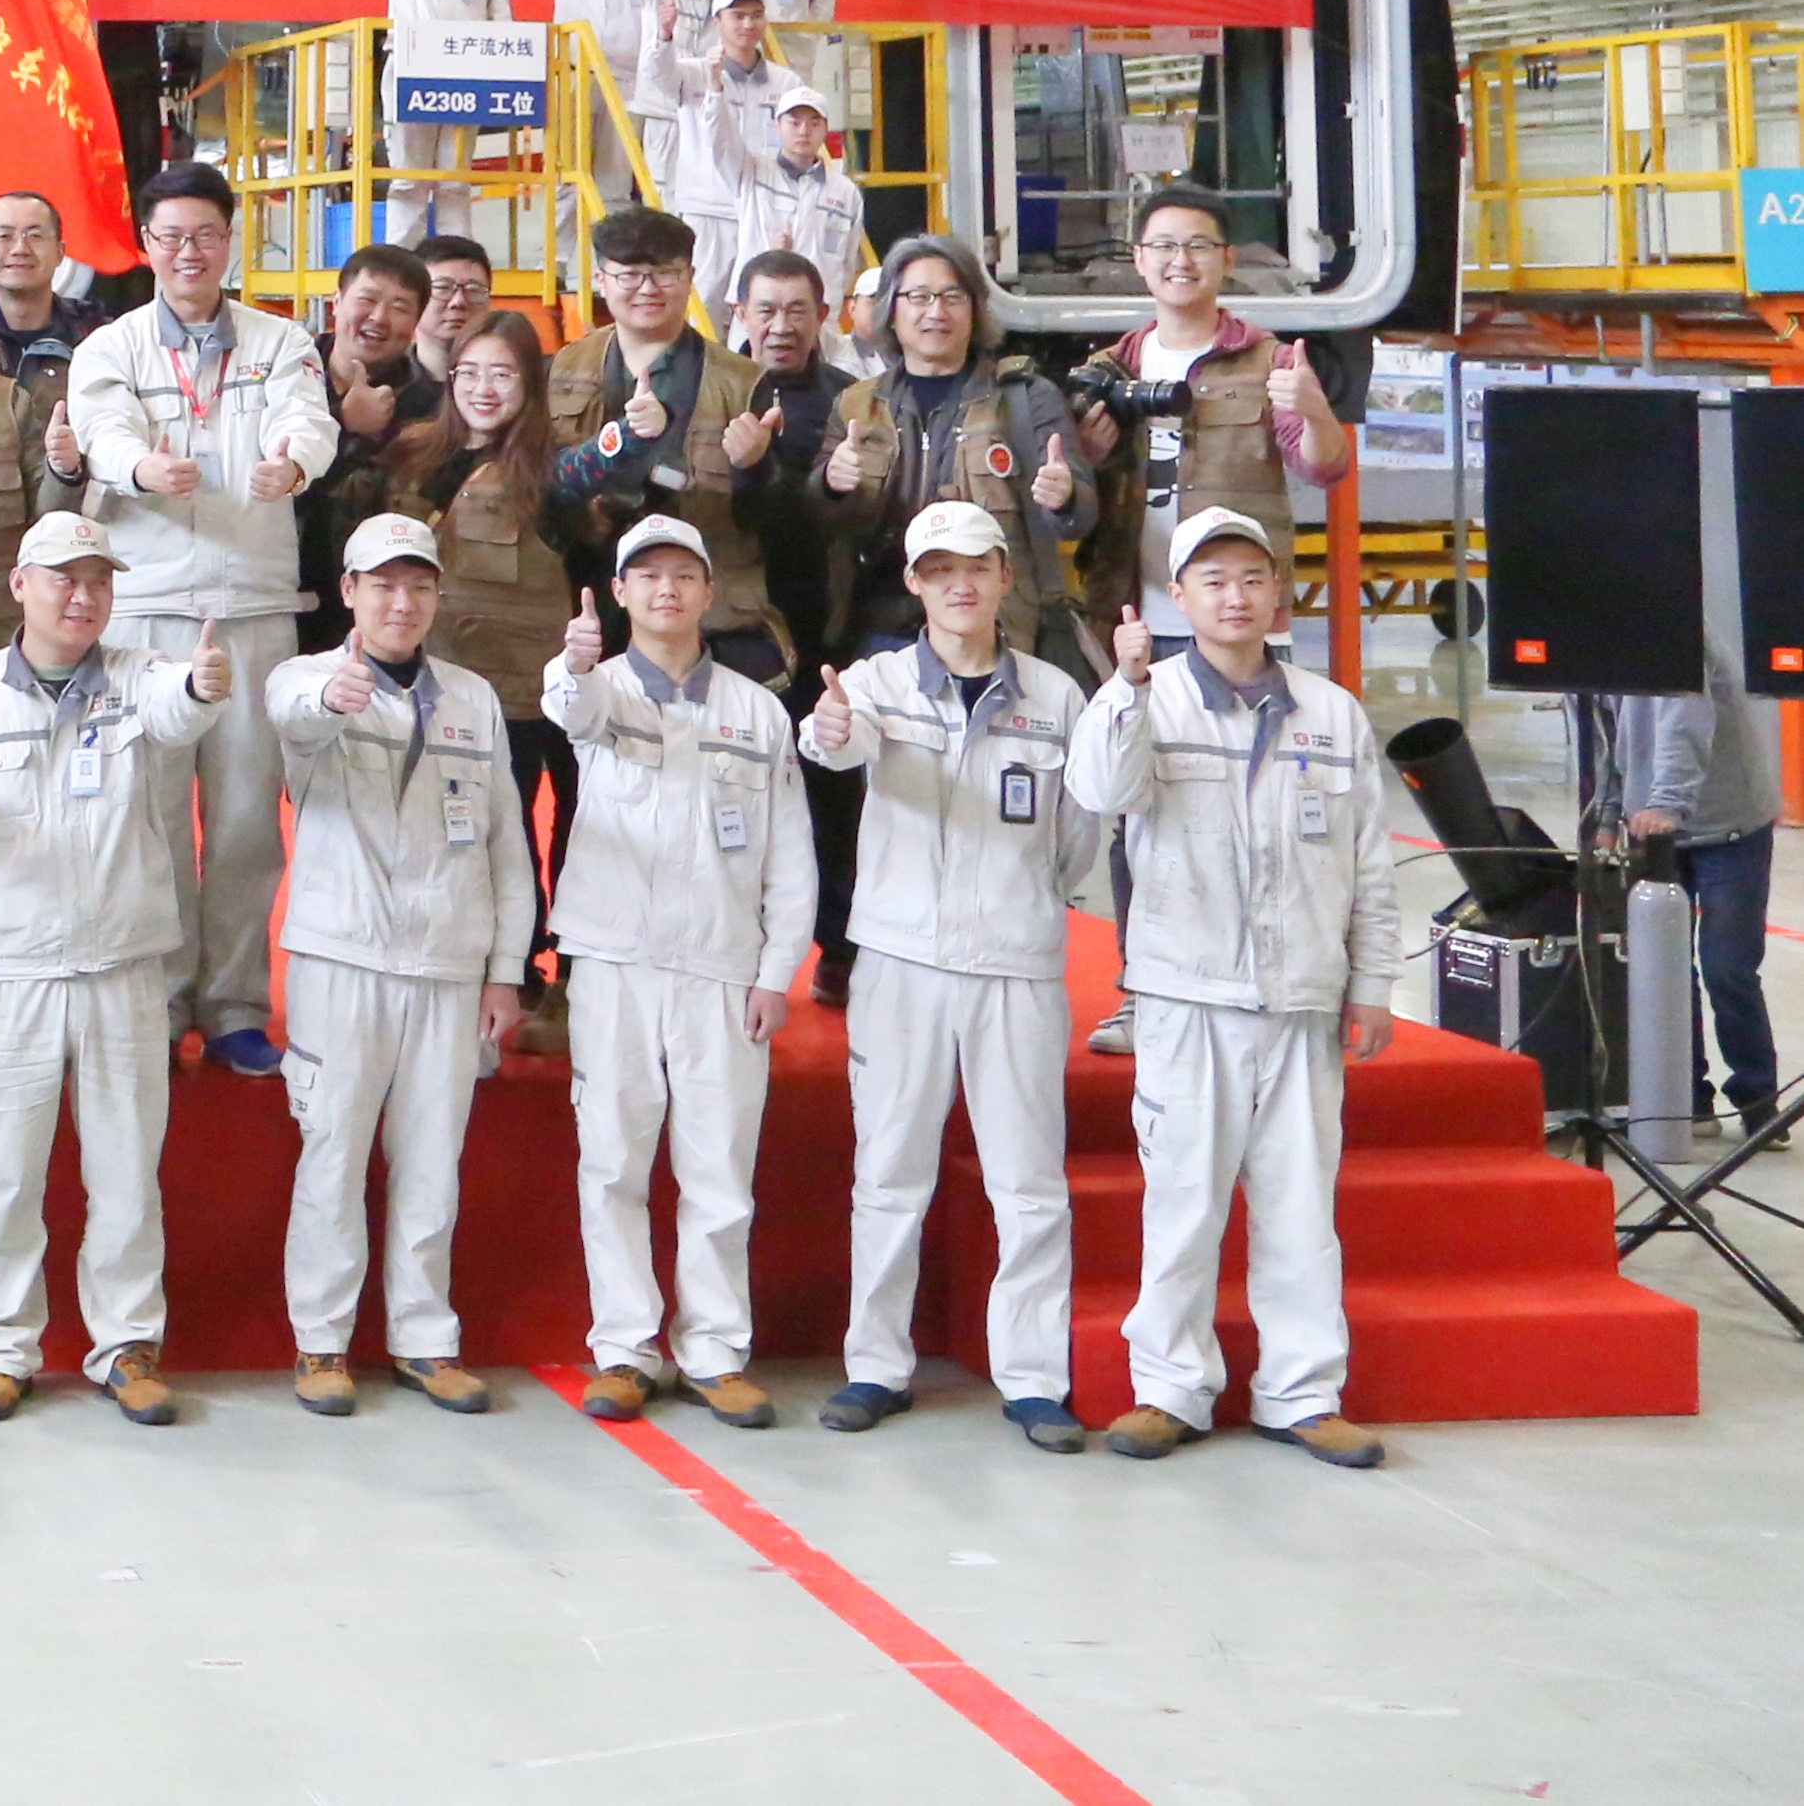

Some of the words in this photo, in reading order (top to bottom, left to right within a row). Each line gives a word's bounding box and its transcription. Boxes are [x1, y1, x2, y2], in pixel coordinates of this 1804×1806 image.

[443, 36, 534, 57] 生产流水线
[406, 89, 477, 114] A2308
[488, 90, 535, 117] 工位
